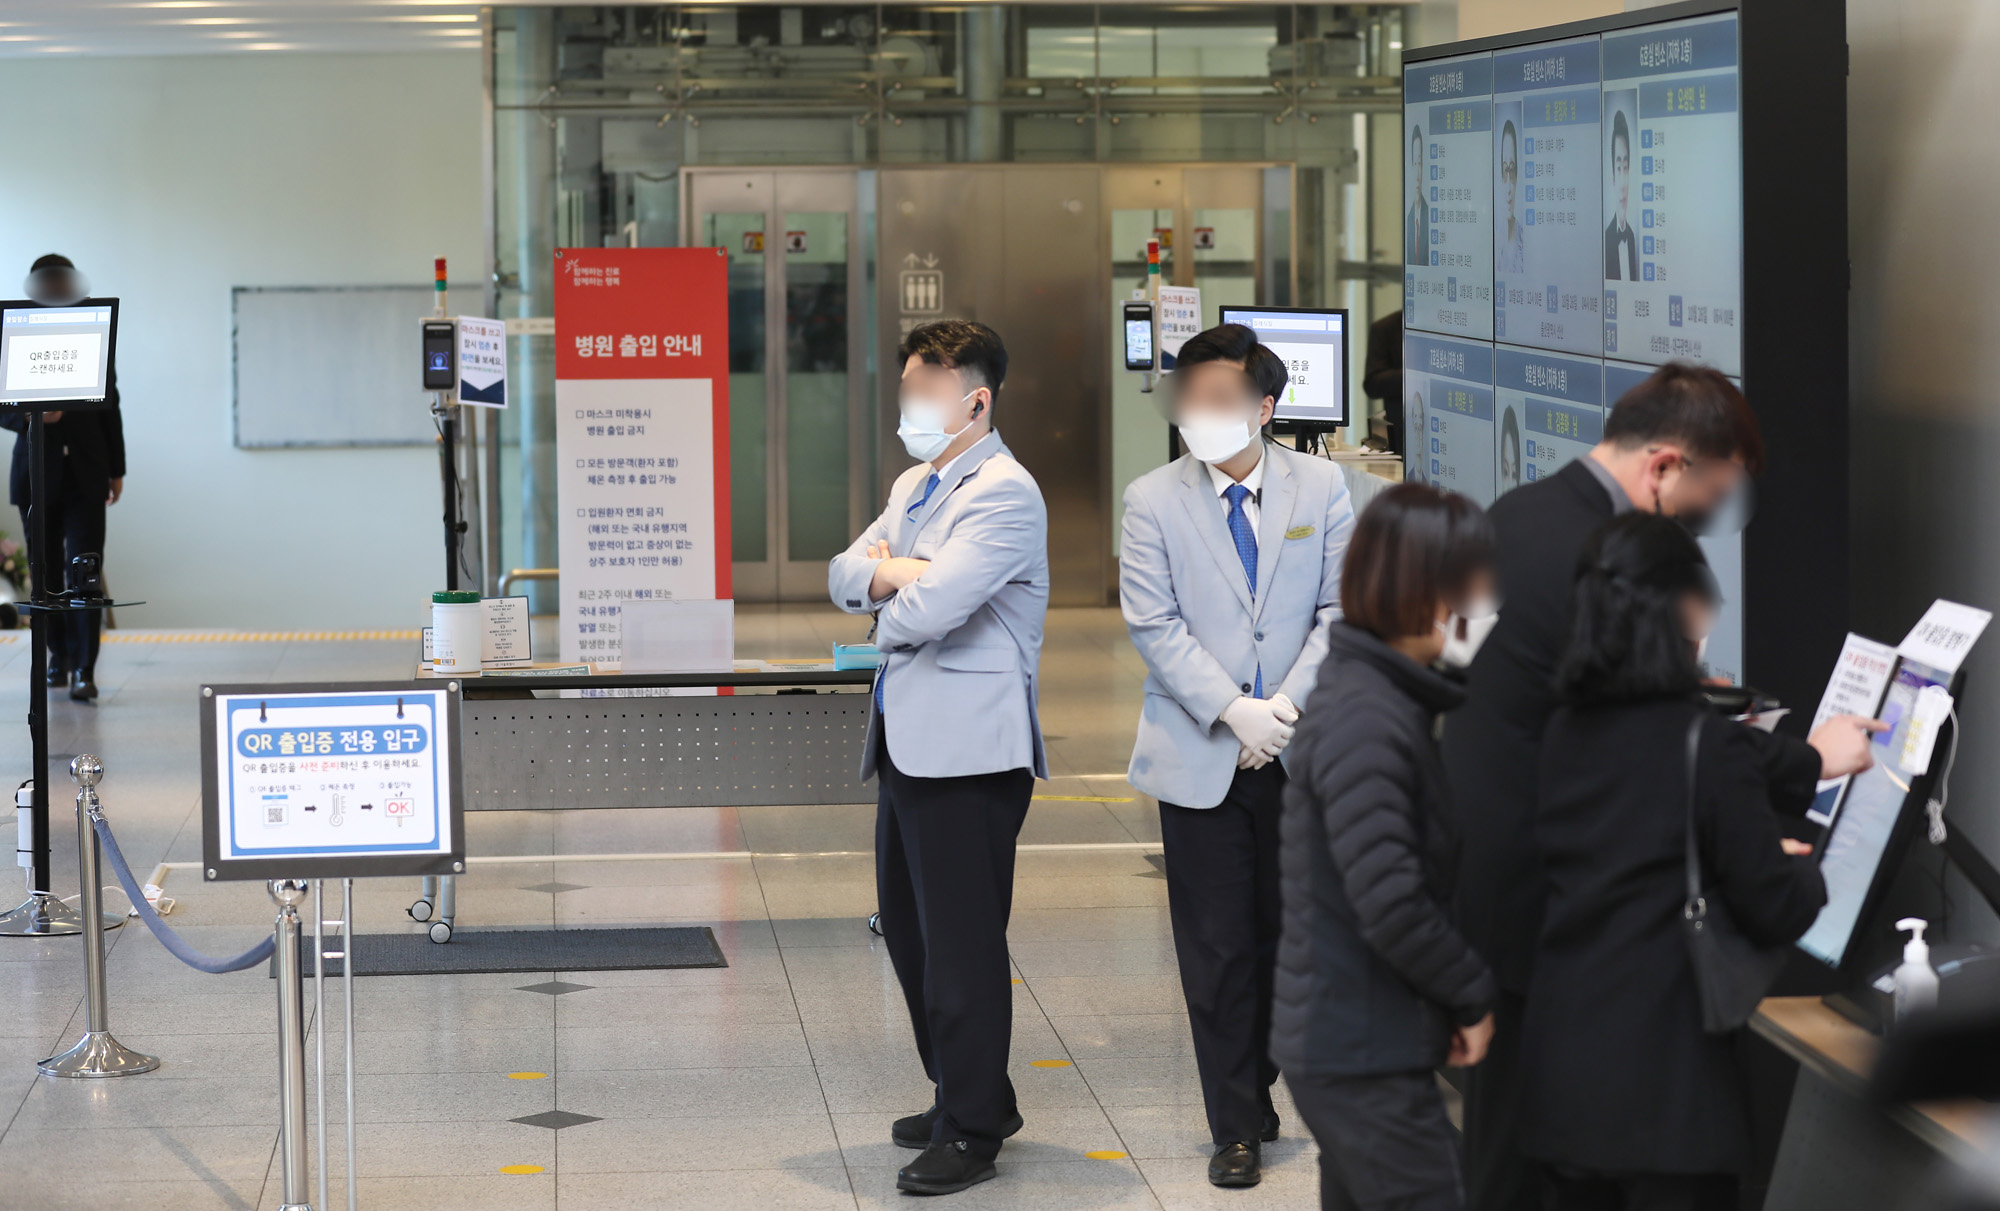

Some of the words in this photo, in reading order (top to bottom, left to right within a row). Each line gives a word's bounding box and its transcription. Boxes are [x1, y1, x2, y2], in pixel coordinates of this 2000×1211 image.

[574, 267, 603, 277] 함께하는
[605, 267, 620, 276] 진료
[574, 277, 603, 286] 함께하는
[1161, 295, 1183, 304] 마스크를
[1185, 296, 1196, 304] 쓰고
[1164, 309, 1175, 318] 잠시
[1176, 309, 1188, 318] 멈춘
[1189, 310, 1194, 318] 후
[461, 324, 486, 336] 마스크를
[488, 325, 501, 337] 쓰고
[1161, 323, 1178, 332] 화면을
[464, 339, 477, 349] 잠시
[478, 340, 491, 351] 멈춘
[493, 342, 499, 351] 후
[575, 334, 614, 357] 병원
[619, 335, 657, 357] 출입
[663, 334, 702, 356] 안내
[30, 350, 78, 361] QR출입증을
[462, 353, 479, 364] 화면을
[30, 364, 76, 374] 스캔하세요.
[1282, 360, 1310, 371] 입증을
[1288, 375, 1309, 385] 세요.
[587, 409, 613, 418] 마스크
[616, 408, 651, 419] 미착용시
[587, 426, 605, 436] 병원
[607, 426, 624, 436] 출입
[627, 425, 644, 435] 금지
[587, 459, 605, 468] 모든
[608, 458, 655, 469] 방문객(환자
[657, 457, 678, 468] 포함)
[588, 475, 605, 485] 체온
[608, 475, 625, 485] 측정
[628, 475, 636, 485] 후
[639, 475, 656, 484] 출입
[659, 474, 676, 484] 가능
[588, 508, 623, 518] 입원환자
[626, 508, 643, 517] 면회
[646, 507, 664, 517] 금지
[588, 524, 609, 535] (해외
[612, 524, 629, 534] 또는
[632, 524, 649, 534] 국내
[652, 523, 687, 533] 유행지역
[588, 541, 624, 551] 방문력이
[626, 541, 644, 551] 없고
[647, 540, 673, 550] 증상이
[676, 540, 693, 550] 없는
[589, 557, 606, 567] 상주
[609, 557, 635, 567] 보호자
[638, 557, 659, 566] 1인만
[662, 556, 682, 567] 허용)
[579, 590, 596, 600] 최근
[598, 590, 612, 599] 2주
[614, 590, 632, 599] 이내
[635, 589, 652, 599] 해외
[655, 589, 672, 599] 또는
[579, 606, 596, 616] 국내
[579, 623, 596, 633] 발열
[599, 623, 616, 633] 또는
[579, 639, 605, 649] 발생한
[244, 734, 272, 752] QR
[278, 732, 334, 754] 출입증
[340, 730, 377, 752] 전용
[383, 729, 420, 751] 입구
[243, 764, 257, 773] QR
[260, 762, 296, 773] 출입증을
[300, 762, 319, 772] 사전
[322, 760, 358, 771] 준비하신
[362, 760, 370, 769] 후
[374, 759, 421, 770] 이용하세요.
[388, 802, 410, 814] OK
